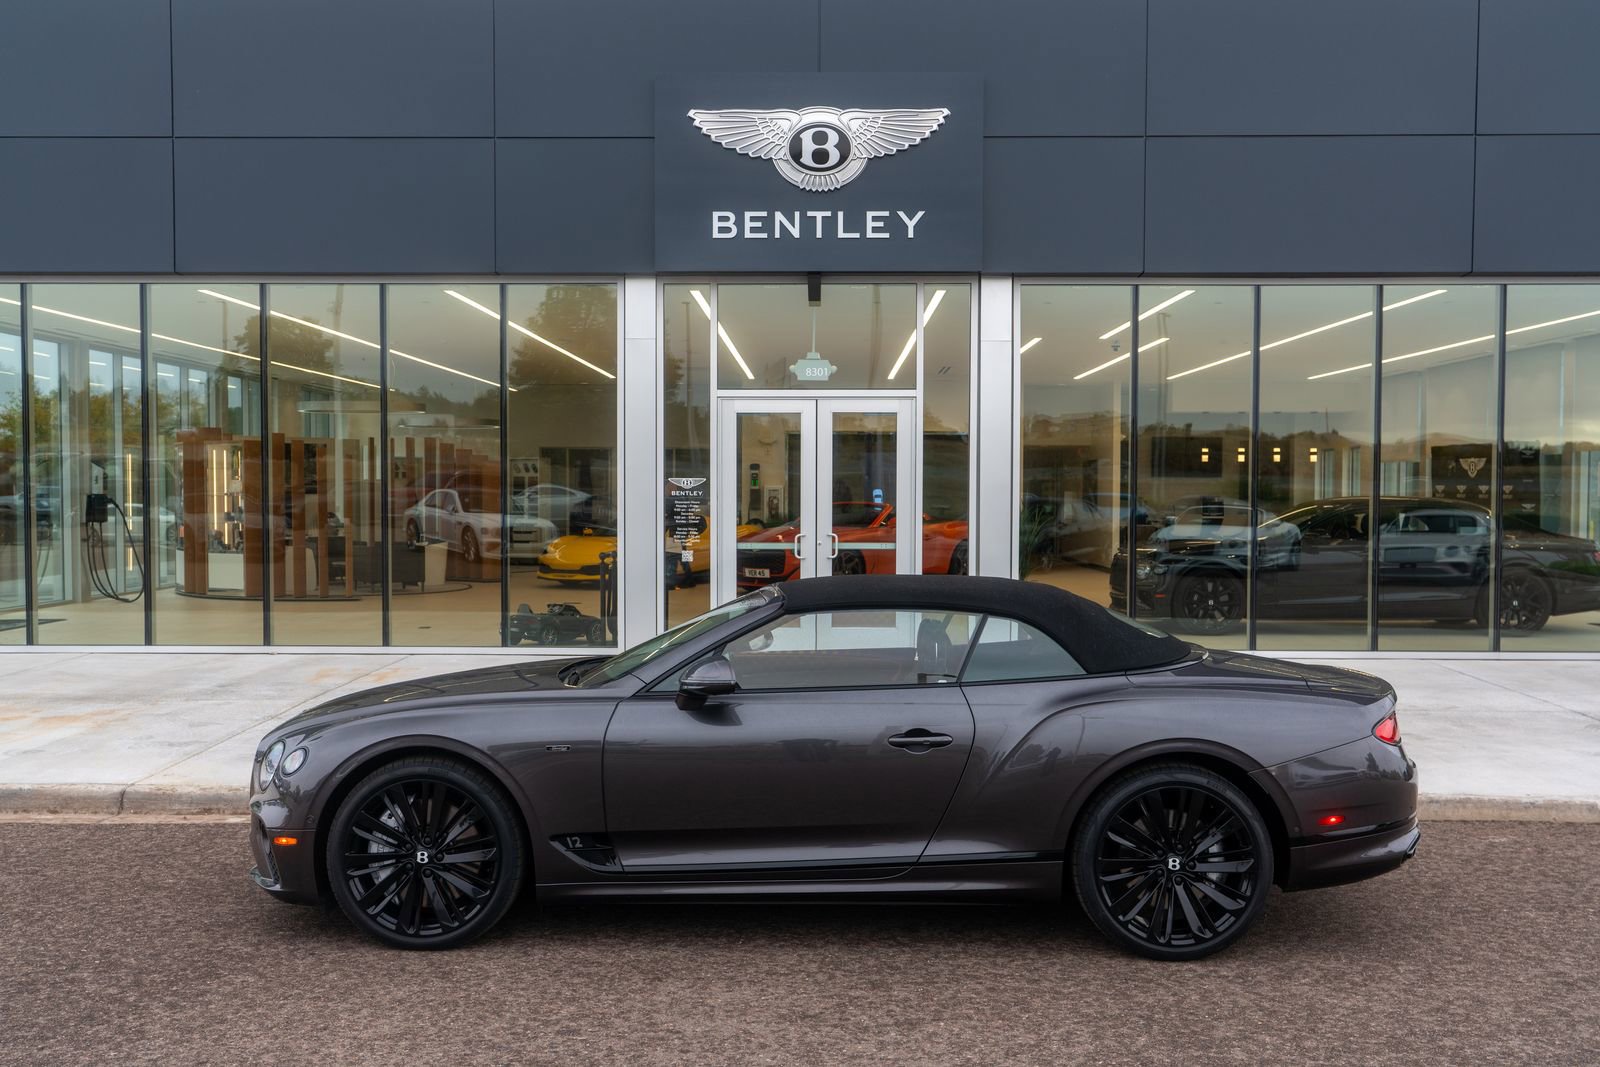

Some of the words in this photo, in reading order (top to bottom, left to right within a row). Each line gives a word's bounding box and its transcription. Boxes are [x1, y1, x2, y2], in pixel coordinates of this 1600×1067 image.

[799, 127, 840, 168] B
[711, 210, 926, 239] BENTLEY
[805, 367, 828, 377] 8301
[416, 851, 429, 864] B
[1168, 857, 1180, 870] B
